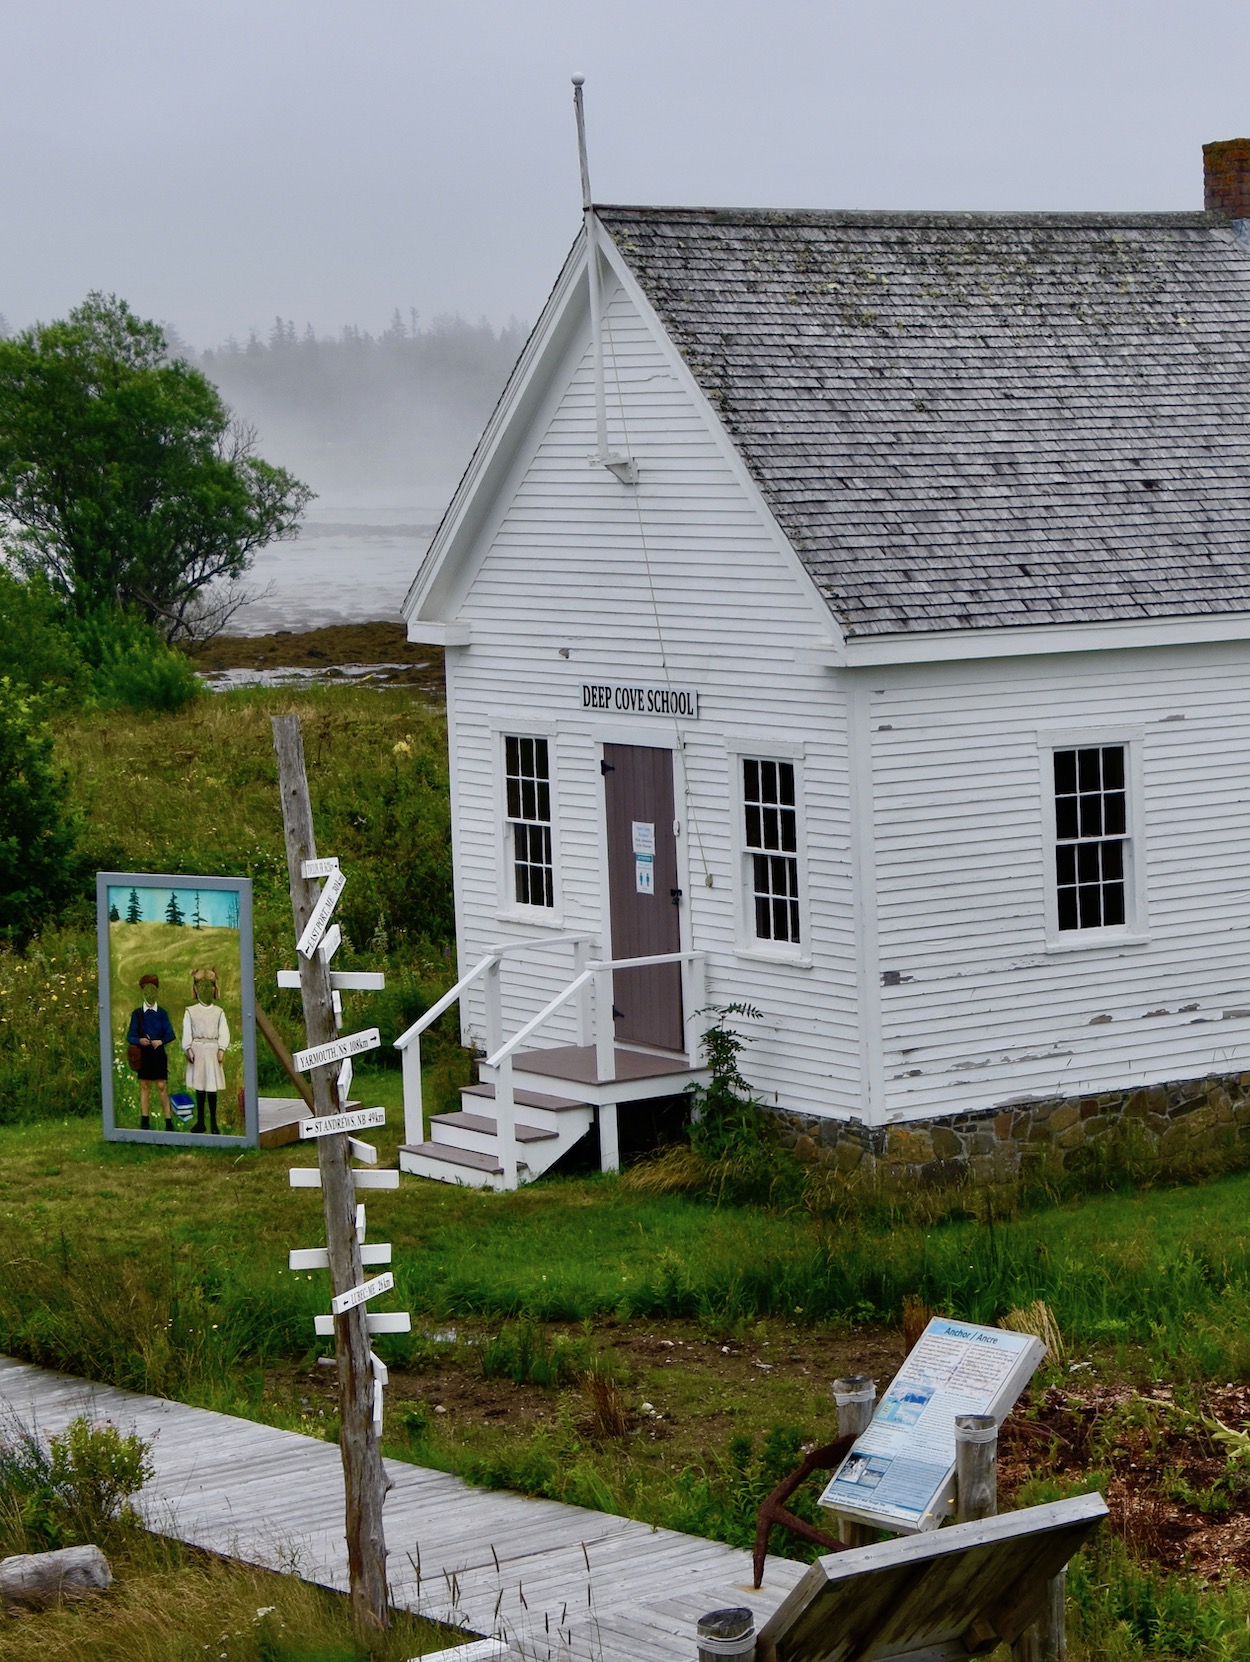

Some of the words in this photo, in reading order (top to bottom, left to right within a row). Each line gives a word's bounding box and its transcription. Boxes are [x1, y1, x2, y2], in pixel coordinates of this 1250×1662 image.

[583, 685, 612, 708] DEEP
[615, 687, 645, 711] COVE
[647, 689, 694, 715] SCHOOL
[338, 1043, 348, 1057] NS
[349, 1038, 369, 1052] 108km
[315, 1121, 322, 1133] ST
[357, 1114, 366, 1126] NB
[368, 1111, 384, 1123] 49km
[944, 1327, 971, 1339] Anchor
[976, 1333, 999, 1344] Ancre
